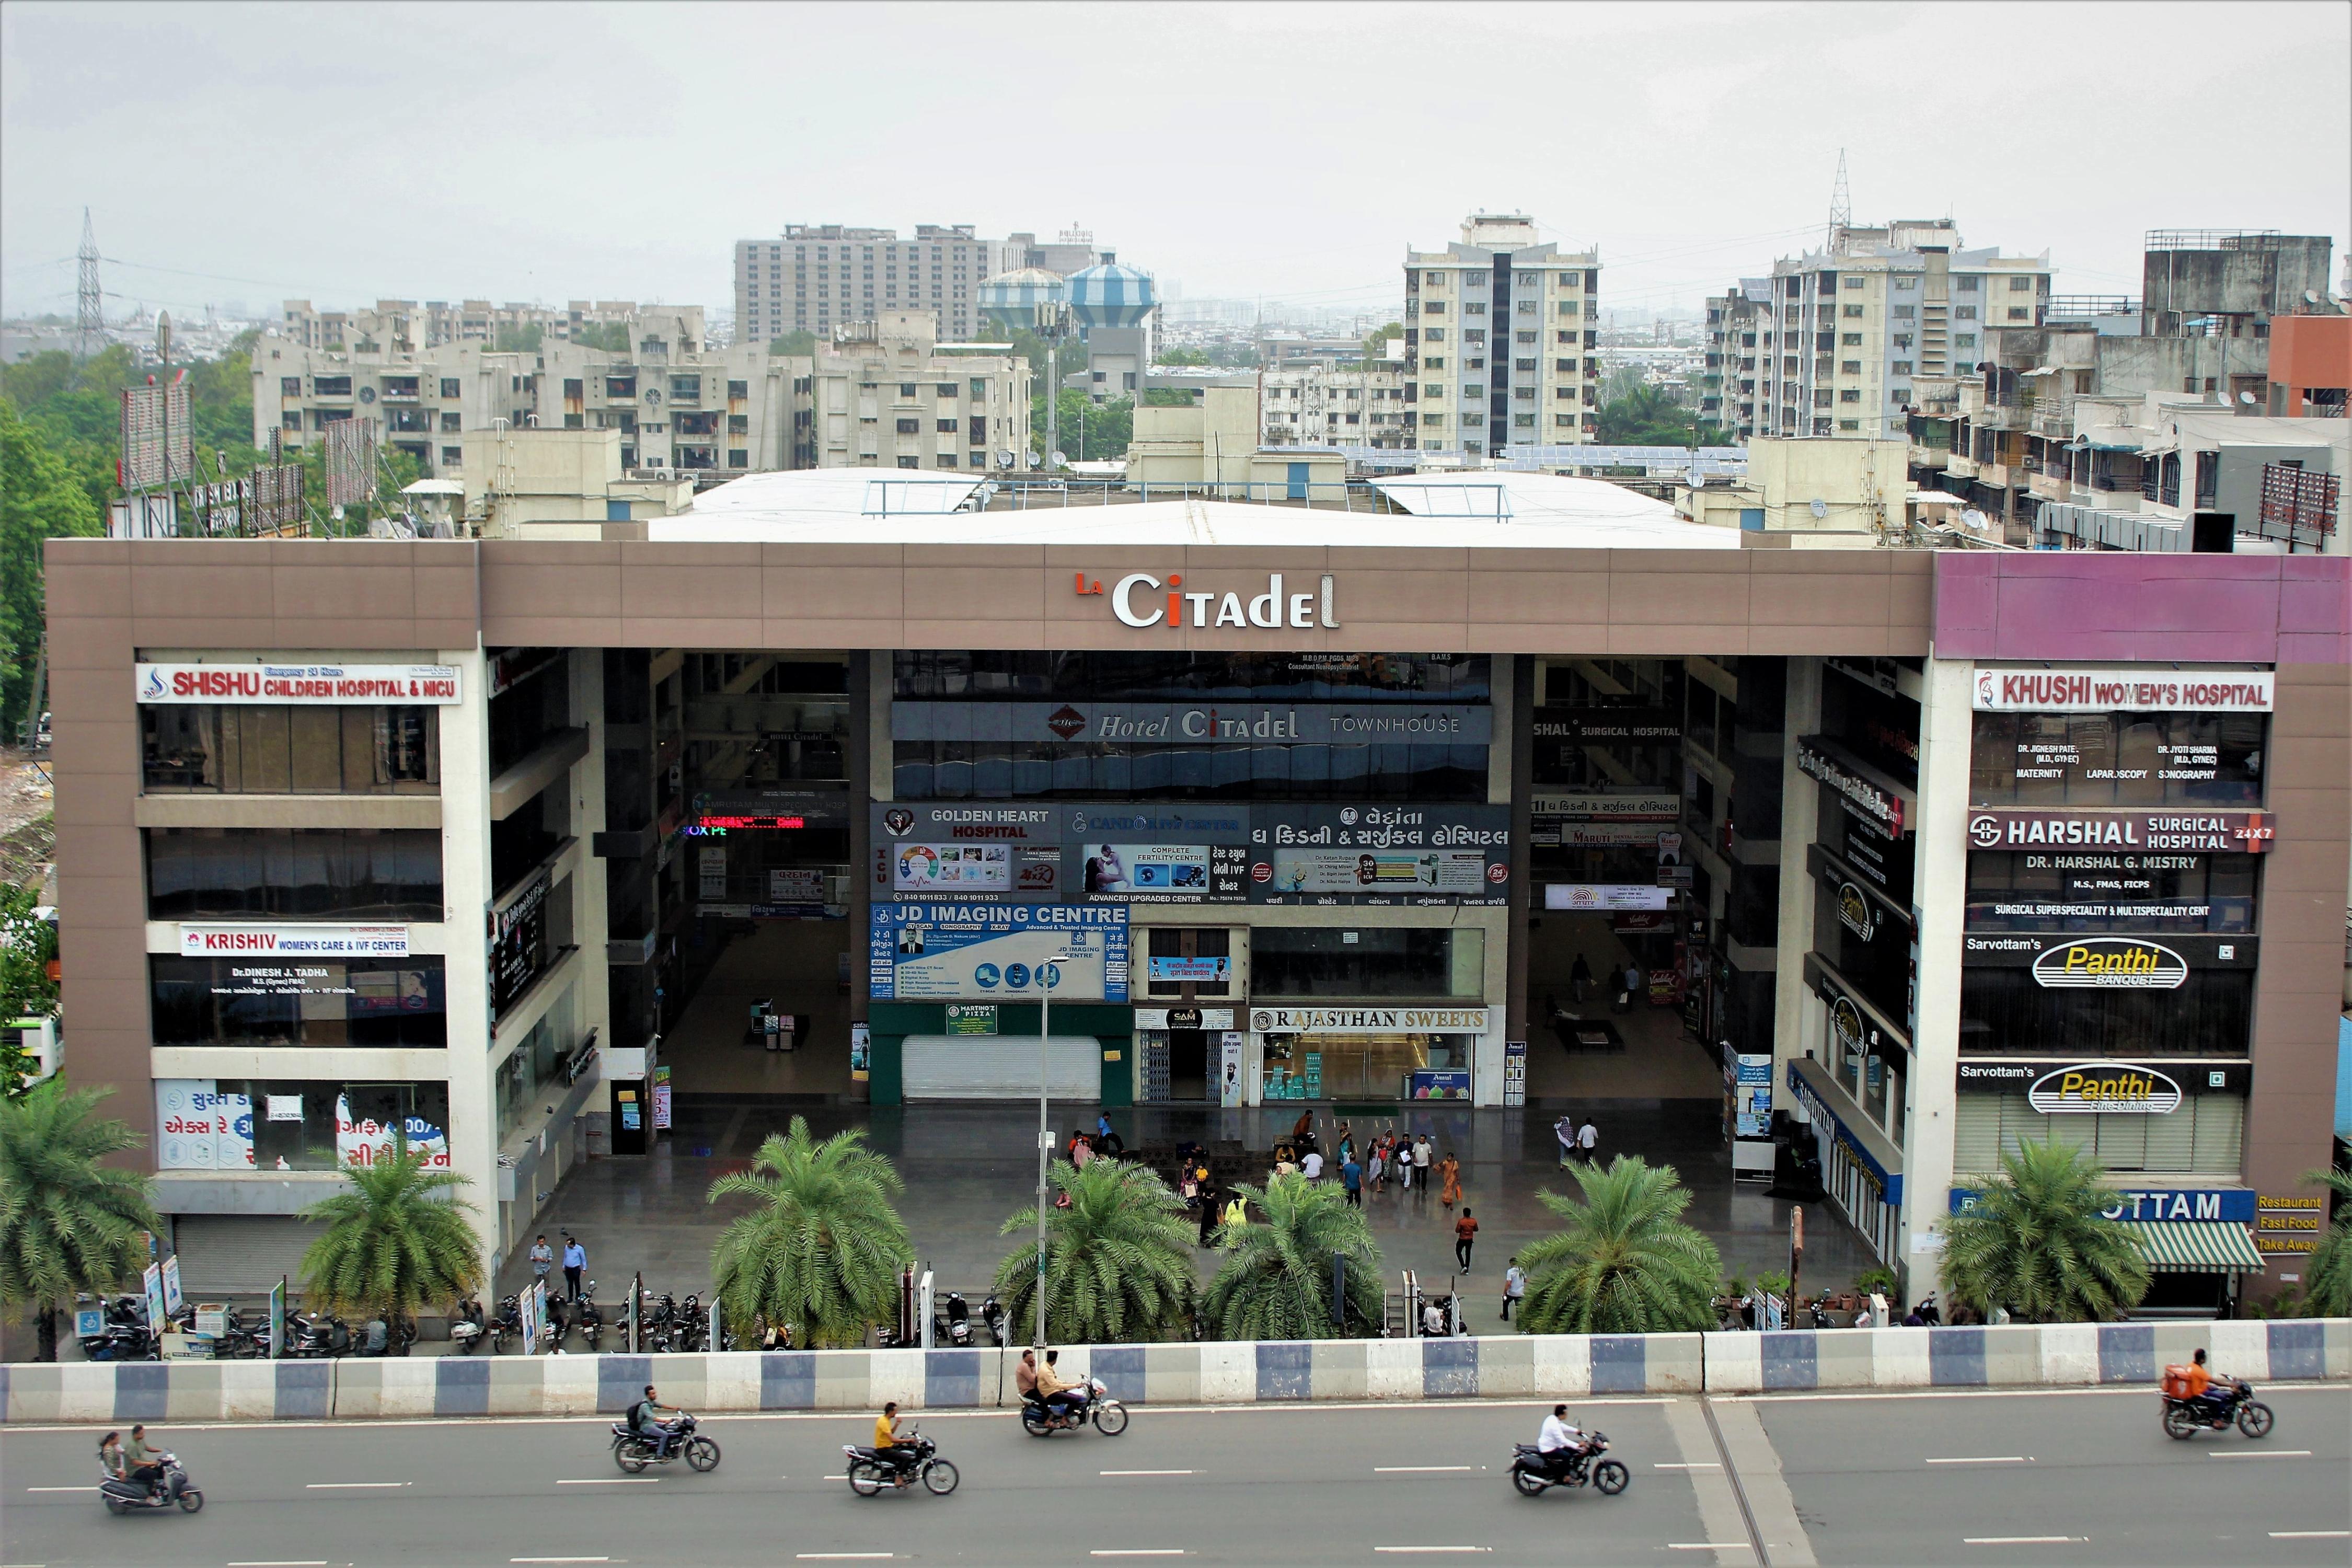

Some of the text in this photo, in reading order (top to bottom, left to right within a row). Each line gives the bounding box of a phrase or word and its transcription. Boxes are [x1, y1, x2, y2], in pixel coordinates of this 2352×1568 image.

[265, 666, 343, 677] Emergency 24 Hours
[1316, 663, 1359, 671] Neuropsychiatrist
[172, 672, 455, 697] SHISHU CHILDREN HOSPITAL & NICU
[2002, 675, 2267, 706] KHUSHI WOMEN'S HOSPITAL
[1098, 715, 1170, 737] Hotel
[1330, 718, 1459, 732] TOWNHOUSE
[1581, 728, 1680, 736] SURGICAL HOSPITAL
[2017, 745, 2058, 753] DR. JIGNESH
[2158, 746, 2217, 754] DR. JYOTI SHARMA
[2193, 755, 2217, 765] GYNEC)
[2016, 769, 2216, 779] MATERNITY LAPAROSCOPY SONOGRAPHY
[1560, 800, 1587, 811] કિડની
[1592, 802, 1598, 811] &
[931, 810, 1049, 822] GOLDEN HEART
[1185, 819, 1239, 831] CENTER
[2148, 817, 2228, 833] SURGICAL
[953, 826, 1028, 838] HOSPITAL
[1252, 824, 1508, 846] ધ કિડની & હોસ્પિટલ
[1573, 833, 1610, 843] MARUTI
[2007, 820, 2138, 845] HARSHAL
[2148, 835, 2228, 850] HOSPITAL
[1214, 862, 1244, 874] બેબી IVF
[2026, 857, 2197, 869] DR. HARSHAL G. MISTRY
[1219, 879, 1238, 891] સેન્ટર
[2096, 881, 2122, 890] FMAS,
[2125, 881, 2150, 889] FICPS
[1266, 896, 1283, 905] પથરી
[894, 906, 1126, 924] JD IMAGING CENTRE
[1995, 905, 2187, 917] SURGICAL SUPERSPECIALITY & MULTISPECIALITY
[205, 933, 407, 950] KRISHIV WOMEN'S CARE & IVF CENTER
[1110, 933, 1124, 941] जे डी
[1967, 938, 2042, 951] Sarvottam's
[2063, 947, 2159, 975] Panthi
[295, 968, 329, 977] TADHA
[2095, 975, 2155, 986] BANQUET
[1276, 1011, 1484, 1031] RAJASTHAN SWEETS
[1961, 1066, 2035, 1078] Sarvottam's
[2059, 1073, 2153, 1101] Panthi
[192, 1093, 228, 1111] સુરત
[2090, 1101, 2153, 1113] Fine Dining
[1800, 1081, 1837, 1141] SARVOTTAM
[165, 1115, 228, 1134] એક્સ રે
[2258, 1195, 2322, 1208] Restaurant
[2259, 1216, 2318, 1229] Fast Food
[2257, 1238, 2318, 1253] Take Away
